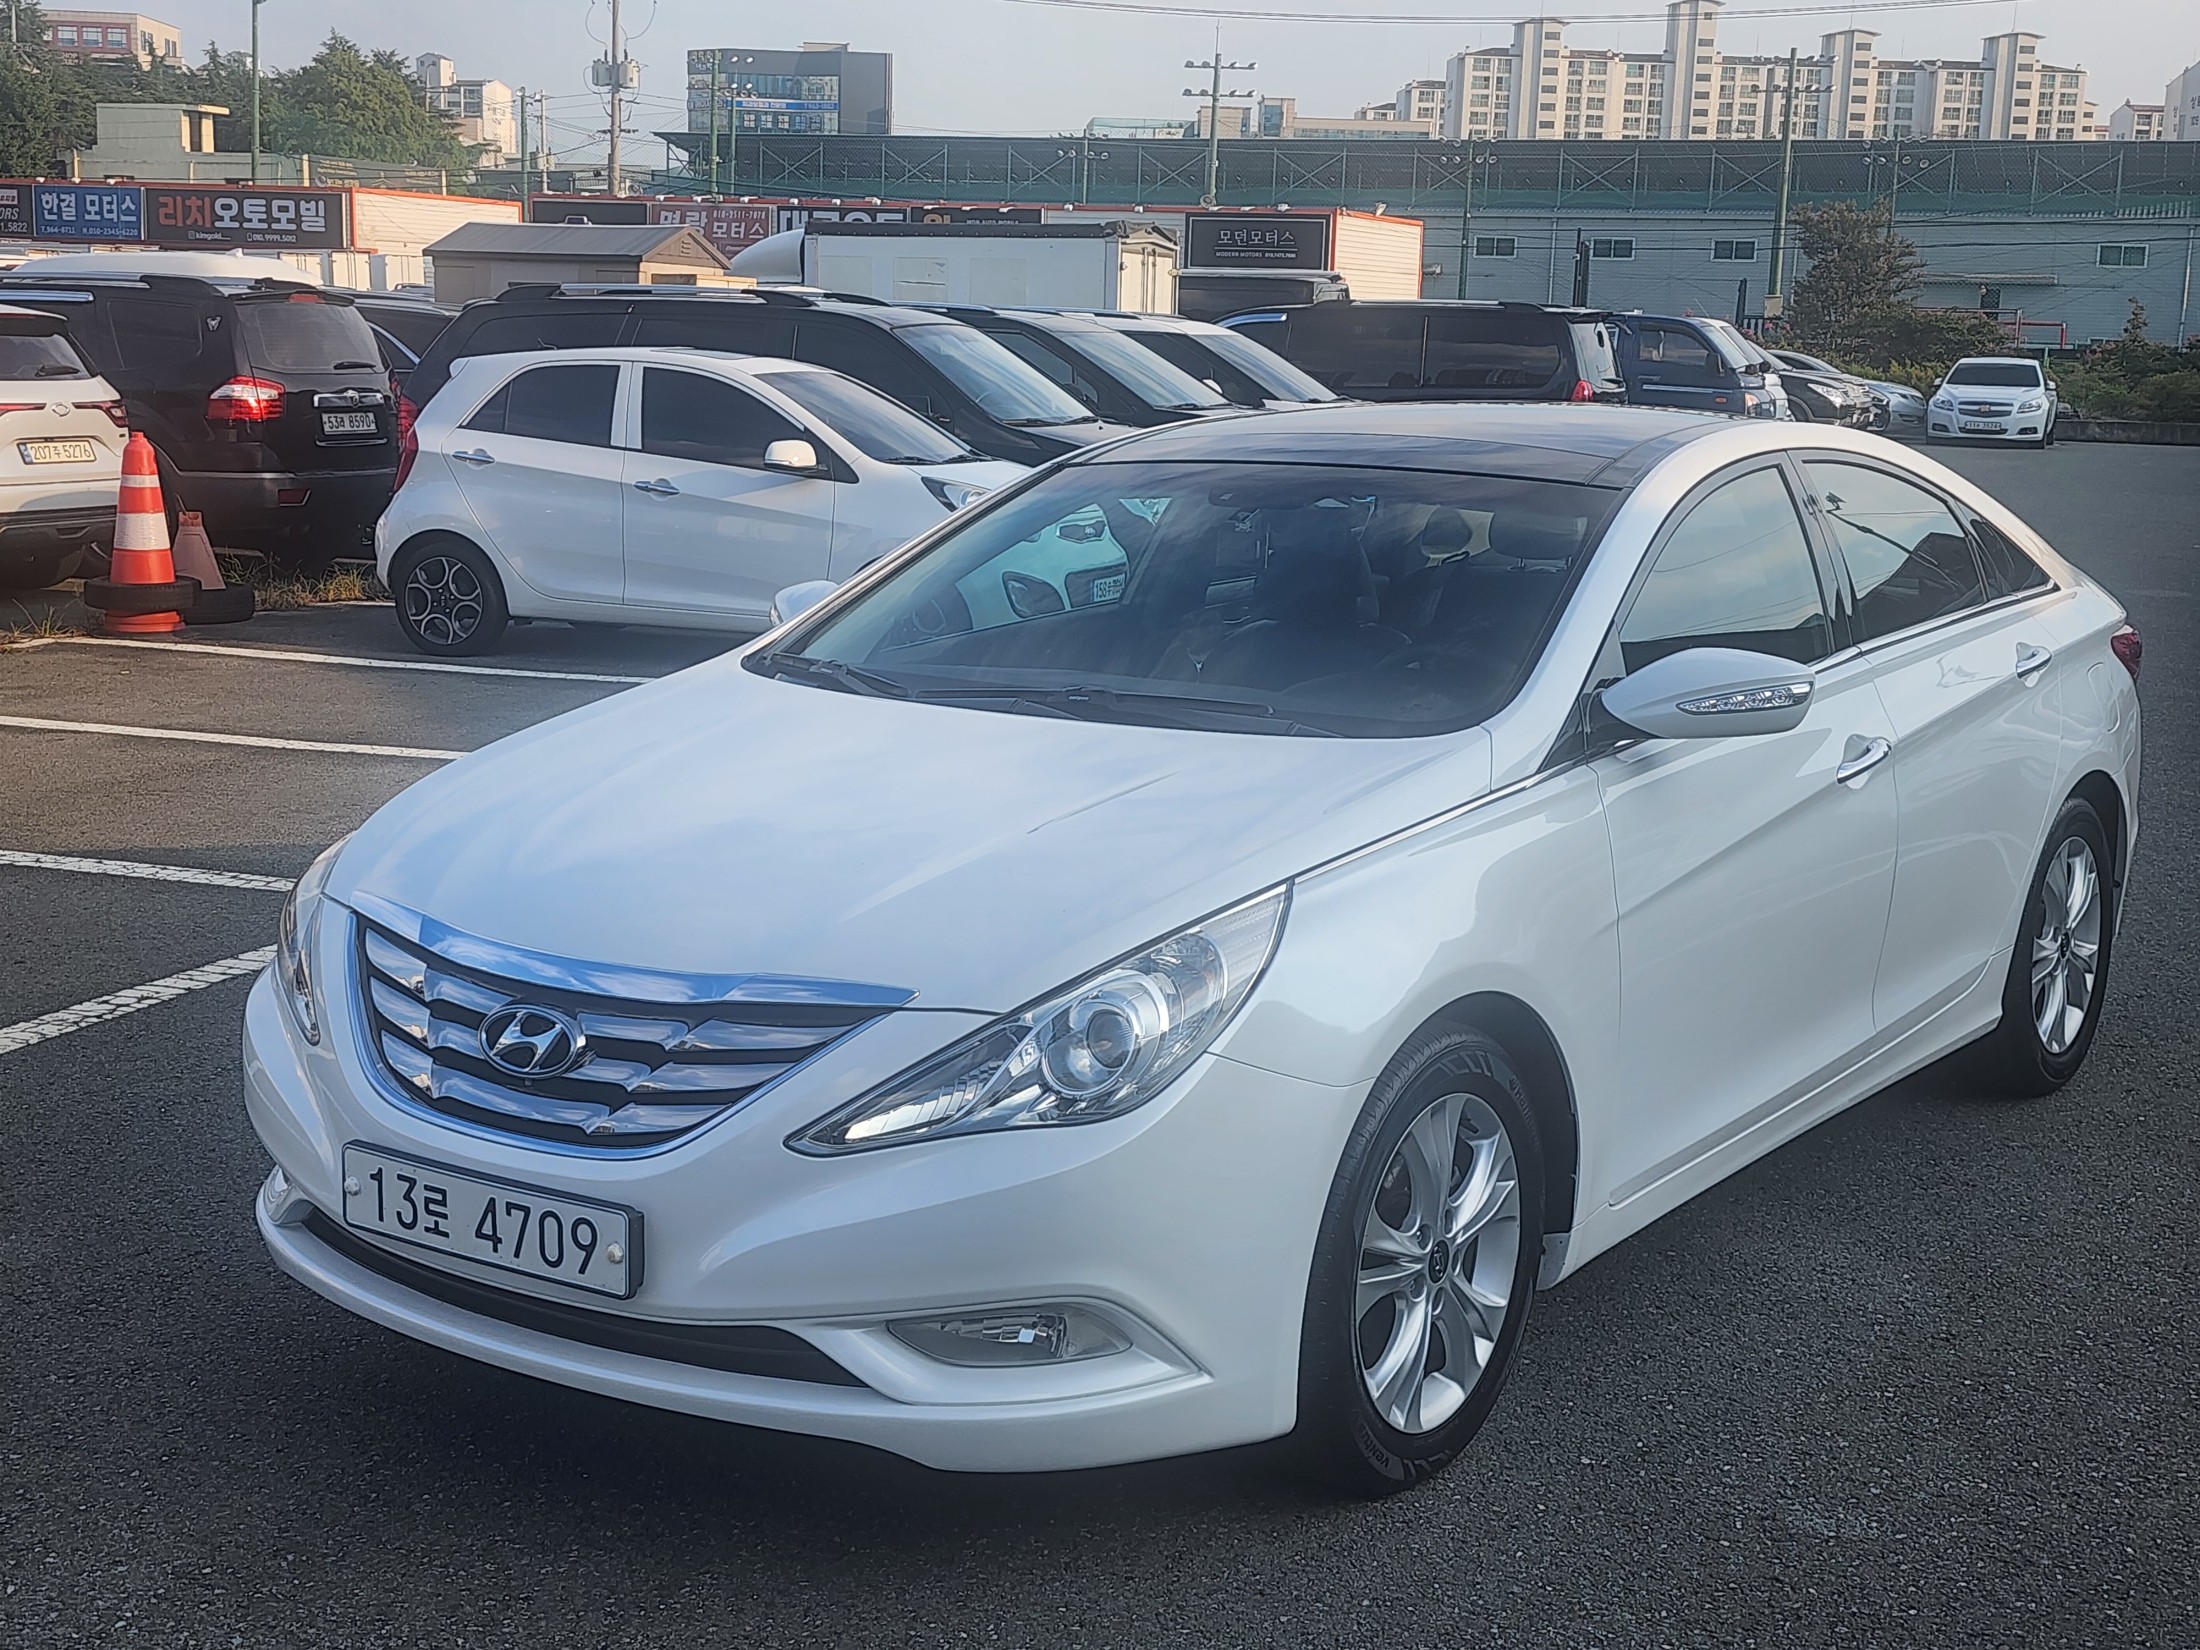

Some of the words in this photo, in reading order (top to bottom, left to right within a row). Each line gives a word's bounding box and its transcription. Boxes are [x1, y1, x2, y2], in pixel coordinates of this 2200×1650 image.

[41, 192, 77, 220] 한결
[84, 194, 137, 222] 모터스
[158, 195, 326, 232] 리치오토모빌
[712, 221, 765, 239] 모터스
[1217, 228, 1295, 247] 모던모터스
[348, 414, 372, 429] 8590
[30, 445, 62, 460] 207주
[62, 444, 92, 459] 5276
[369, 1166, 450, 1239] 13로
[474, 1196, 599, 1275] 4709
